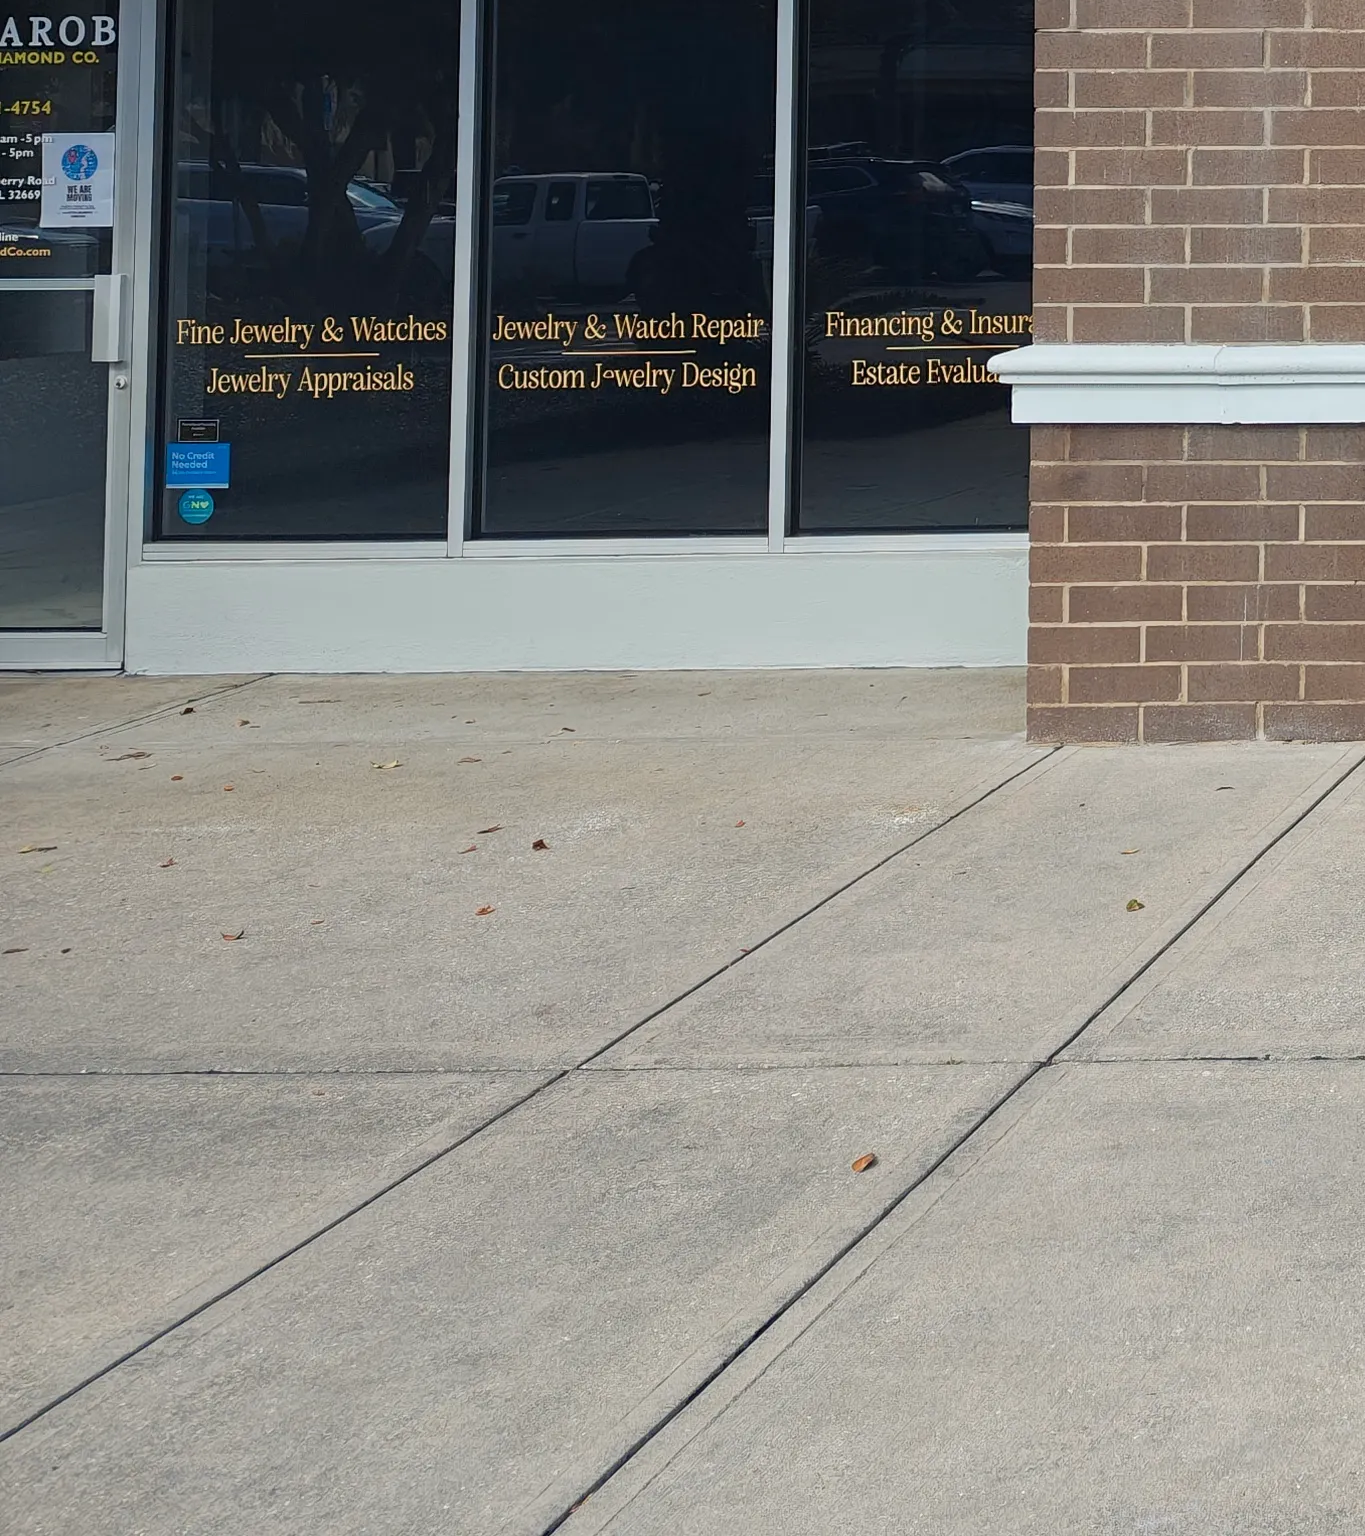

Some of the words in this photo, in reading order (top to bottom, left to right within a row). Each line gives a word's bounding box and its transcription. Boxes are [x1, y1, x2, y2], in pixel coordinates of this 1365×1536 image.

[0, 15, 117, 47] AROB
[72, 51, 100, 64] CO.
[9, 147, 34, 159] 5pm
[8, 189, 41, 200] 32669
[175, 319, 225, 345] Fine
[229, 316, 315, 350] Jewelry
[320, 316, 344, 344] &
[350, 314, 447, 342] Watches
[492, 313, 578, 346] Jewelry
[584, 313, 607, 340] &
[613, 312, 686, 340] Watch
[691, 312, 765, 345] Repair
[824, 310, 935, 342] Financing
[940, 309, 963, 336] &
[206, 365, 292, 400] Jewelry
[297, 363, 414, 399] Appraisals
[498, 363, 586, 390] Custom
[590, 361, 676, 395] Jewelry
[682, 361, 757, 394] Design
[851, 359, 921, 386] Estate
[171, 451, 186, 460] No
[187, 451, 215, 460] Credit
[171, 460, 208, 469] Needed
